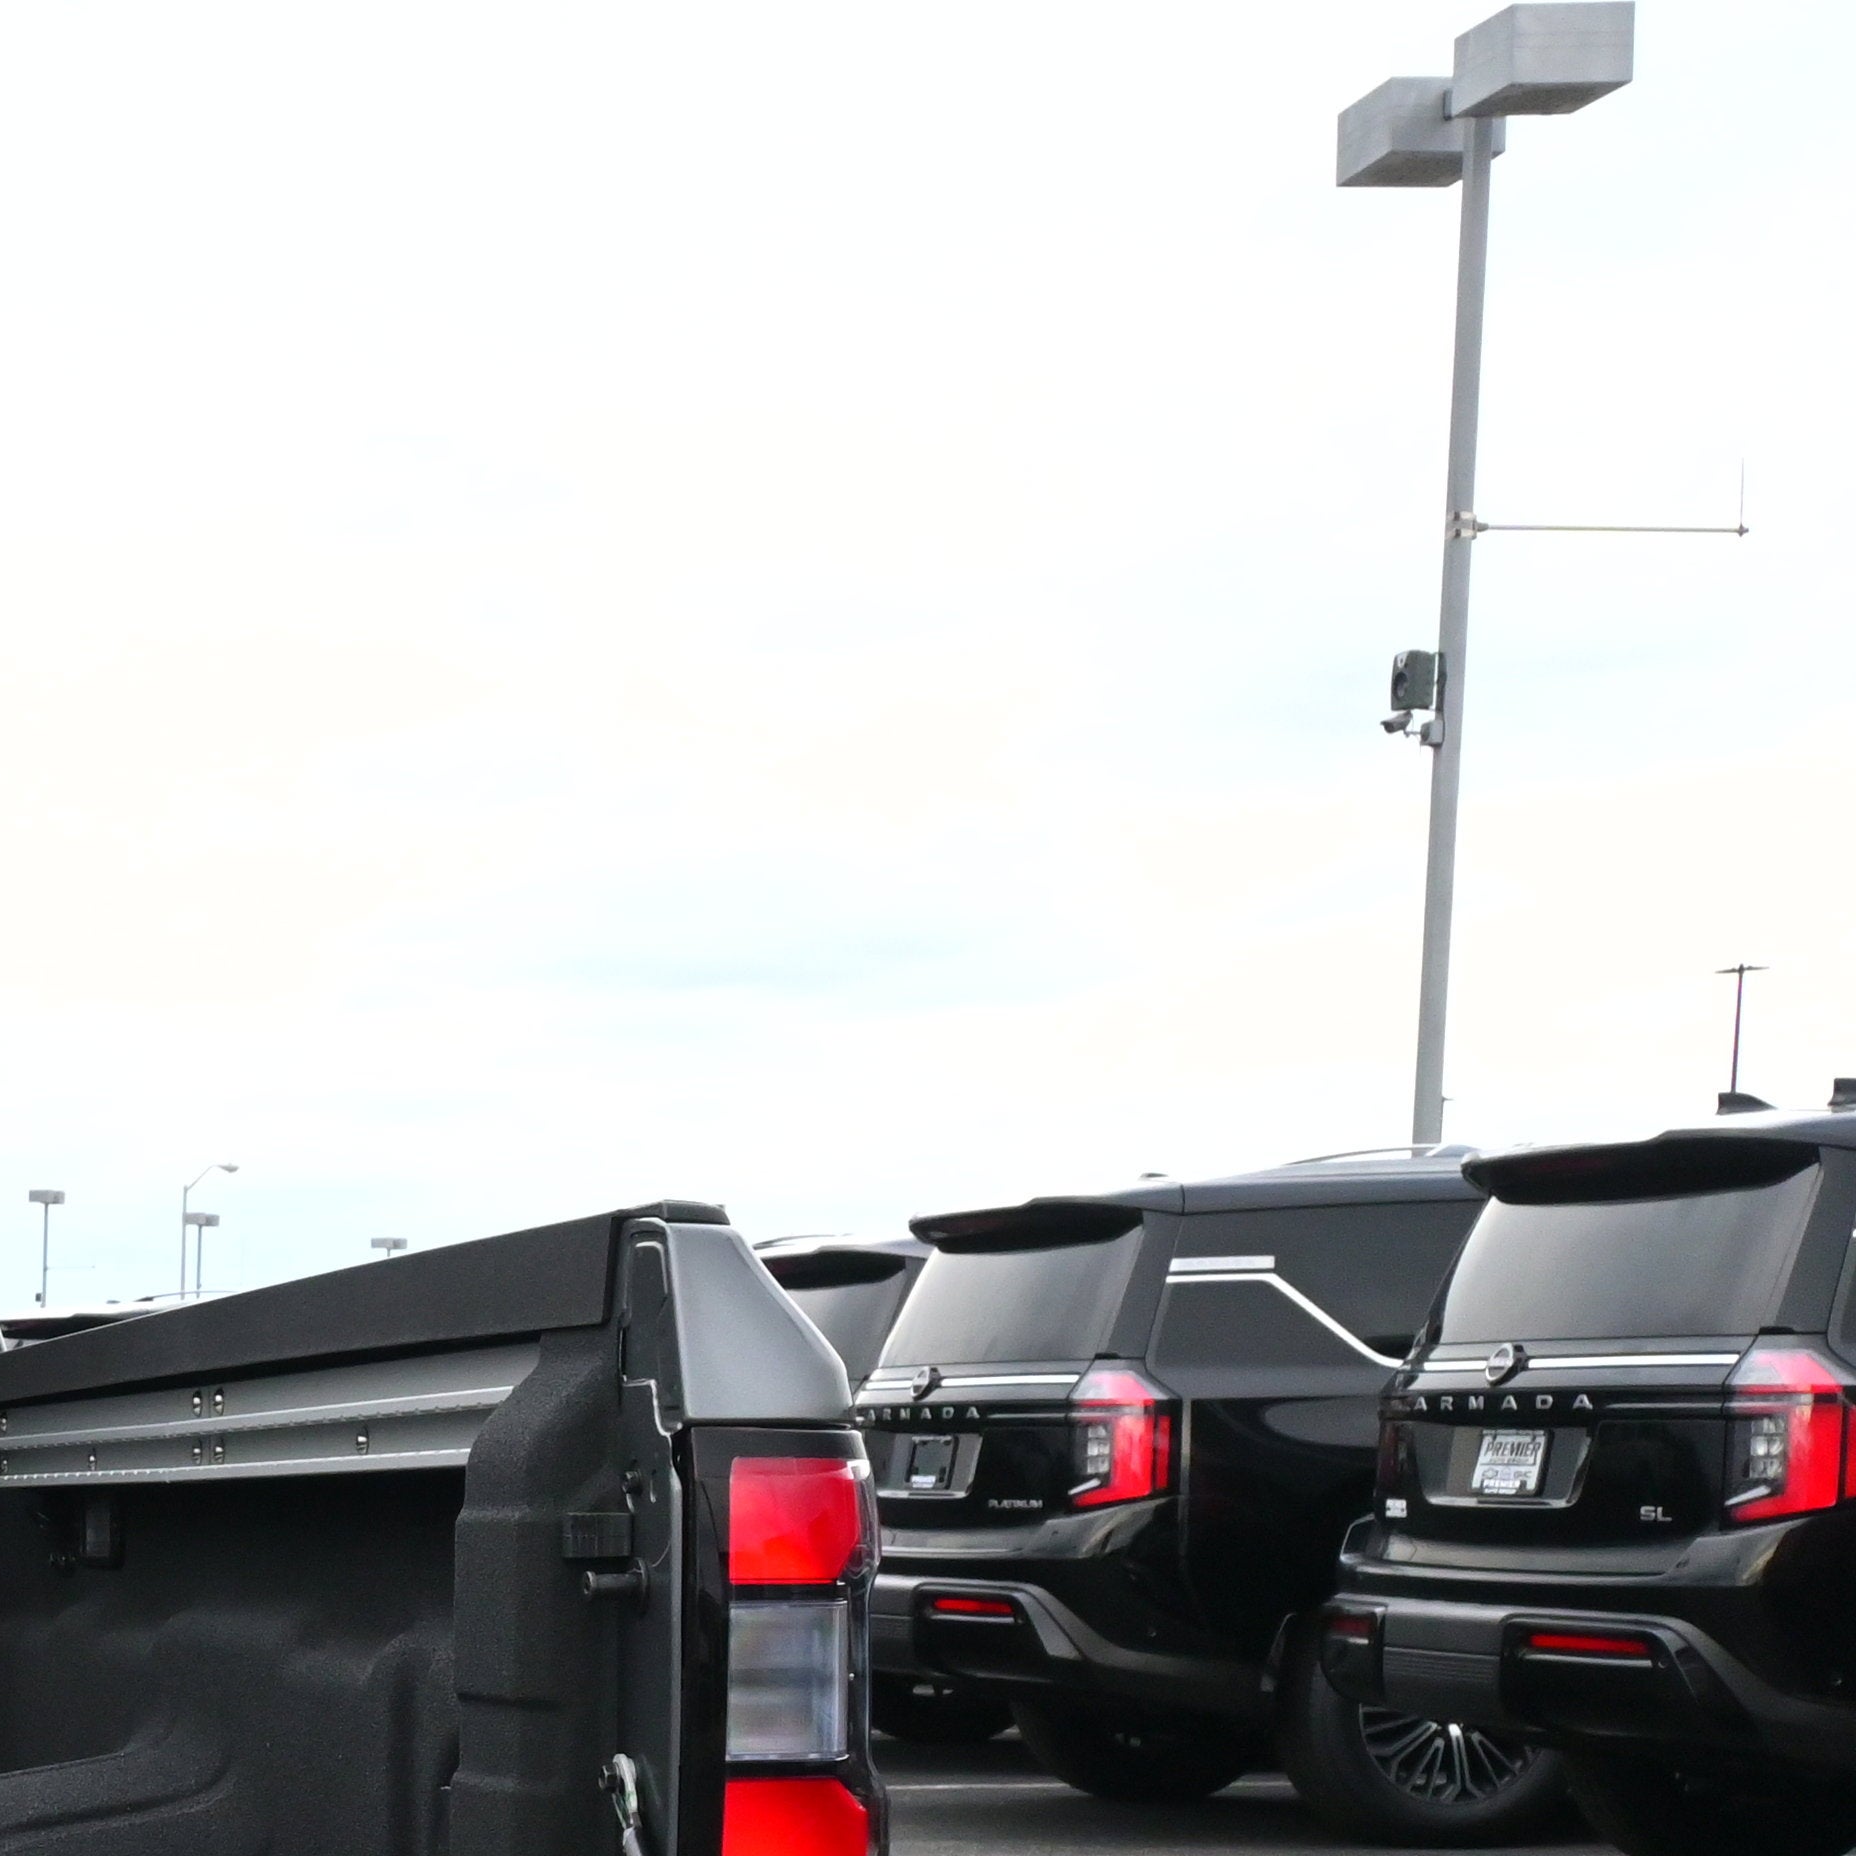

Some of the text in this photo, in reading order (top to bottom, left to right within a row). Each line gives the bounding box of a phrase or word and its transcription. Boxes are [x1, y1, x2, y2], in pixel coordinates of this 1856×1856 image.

[1413, 1395, 1593, 1411] ARMADA
[866, 1407, 980, 1421] ARMADA
[1484, 1441, 1542, 1457] PREMIER
[1640, 1505, 1672, 1521] SL
